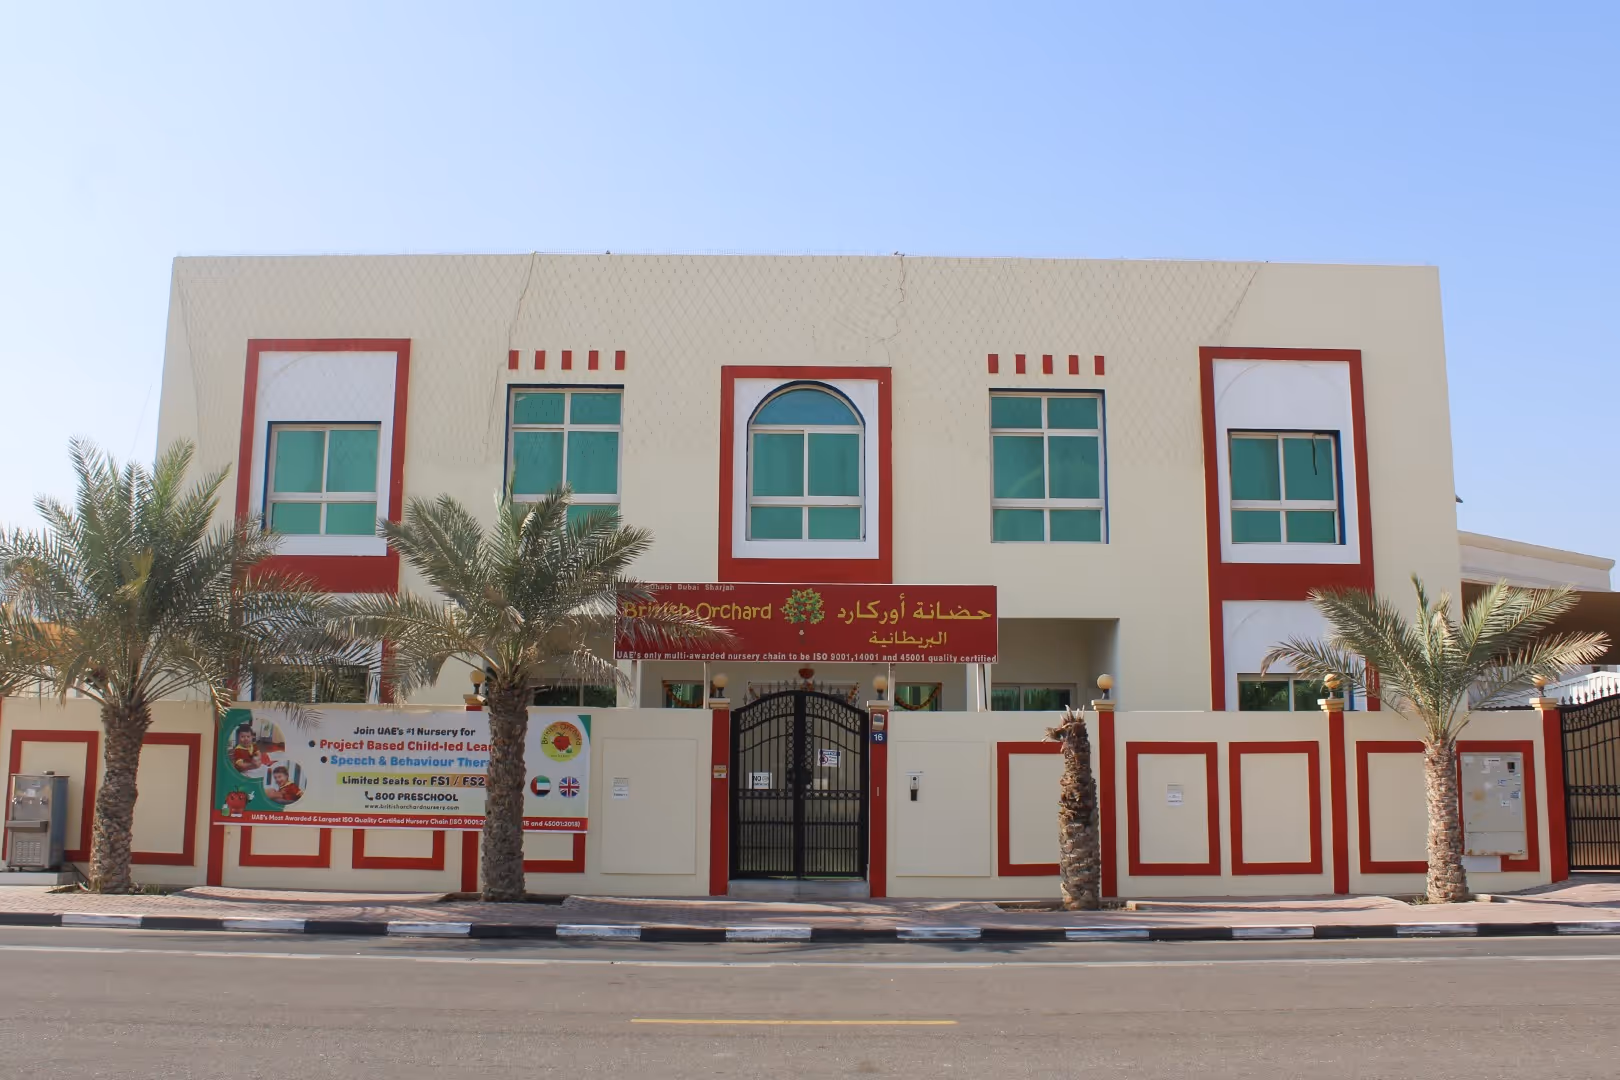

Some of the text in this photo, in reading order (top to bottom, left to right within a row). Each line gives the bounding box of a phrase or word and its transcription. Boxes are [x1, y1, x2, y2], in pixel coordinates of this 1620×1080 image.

[705, 584, 735, 592] Sharjah
[695, 602, 772, 620] Orchard
[837, 592, 992, 624] حضانة أوركارد
[868, 630, 947, 649] البريطانية
[616, 651, 641, 659] UAE's
[644, 651, 662, 660] only
[664, 651, 725, 660] multi-awarded
[728, 652, 760, 661] nursery
[762, 652, 786, 660] chain
[830, 653, 879, 661] 9001,14001
[882, 653, 897, 661] and
[900, 653, 925, 661] 45001
[928, 654, 958, 663] quality
[960, 654, 997, 662] certified
[354, 726, 375, 735] Join
[378, 727, 404, 735] UAE's
[417, 727, 458, 737] Nursery
[460, 728, 476, 736] for
[873, 733, 883, 741] 16
[320, 739, 493, 752] Project Based Child-led Lear
[330, 755, 490, 767] Speech & Behaviour Ther
[342, 776, 485, 786] Limited Seats for FS1 / FS2
[375, 792, 458, 801] 800 PRESCHOOL
[354, 816, 377, 824] Quality
[405, 818, 429, 826] Nursery
